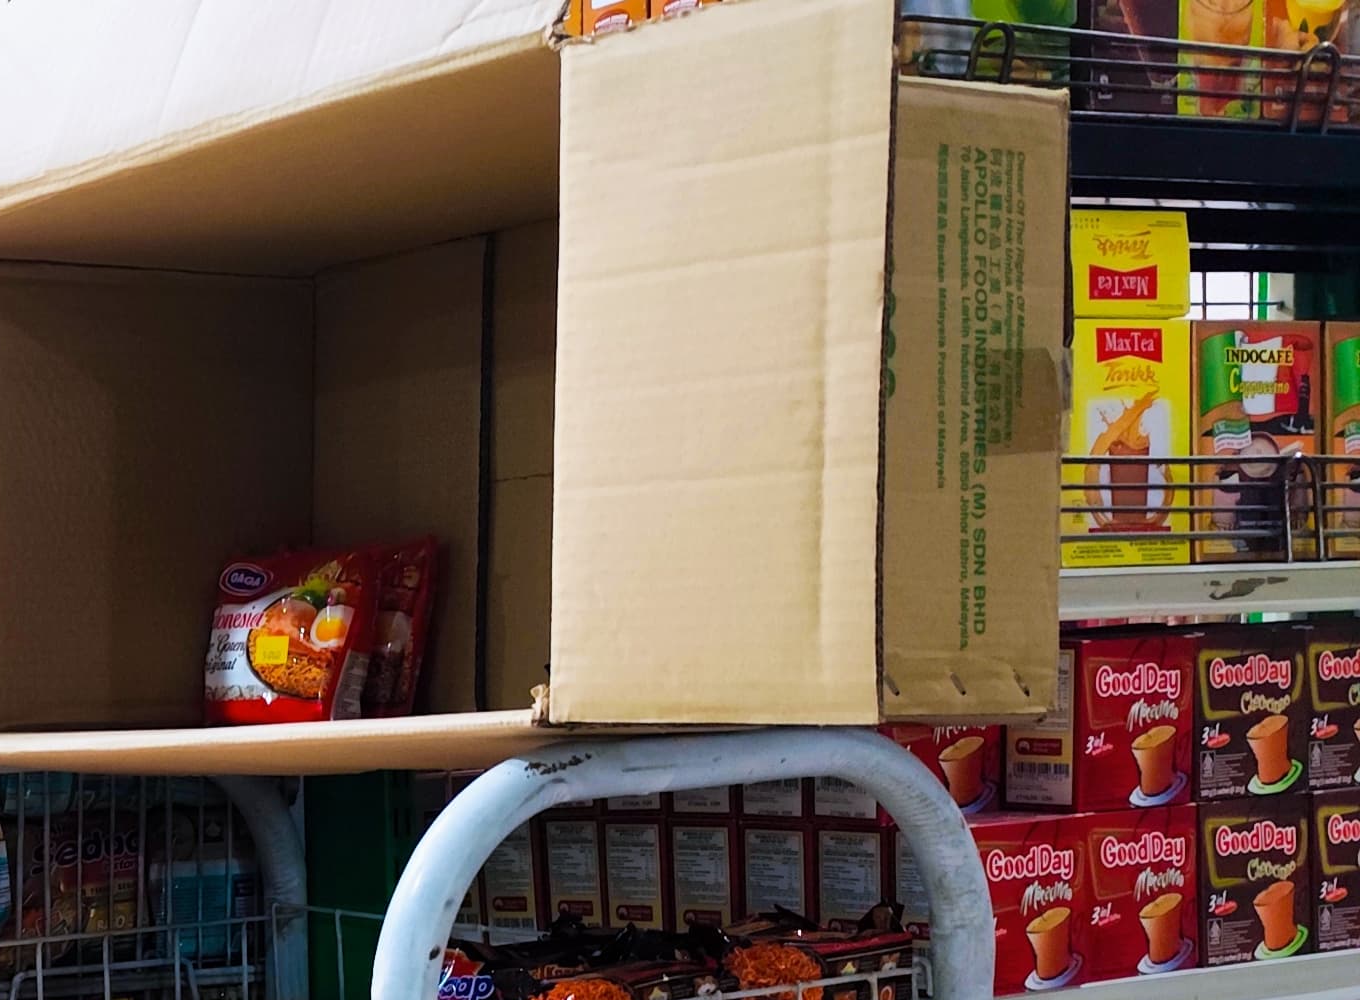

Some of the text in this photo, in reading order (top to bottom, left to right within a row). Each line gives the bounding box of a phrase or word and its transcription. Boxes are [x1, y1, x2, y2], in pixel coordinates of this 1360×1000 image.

[1103, 330, 1156, 353] MaxTea
[960, 342, 971, 406] Industrial
[971, 147, 988, 635] APOLLO FOOD INDUSTRIES (M) SDN BHD
[935, 425, 946, 489] Malaysia
[960, 495, 971, 535] Johor
[230, 569, 264, 587] GAGA
[214, 604, 265, 630] donesia
[1328, 813, 1360, 843] Goo
